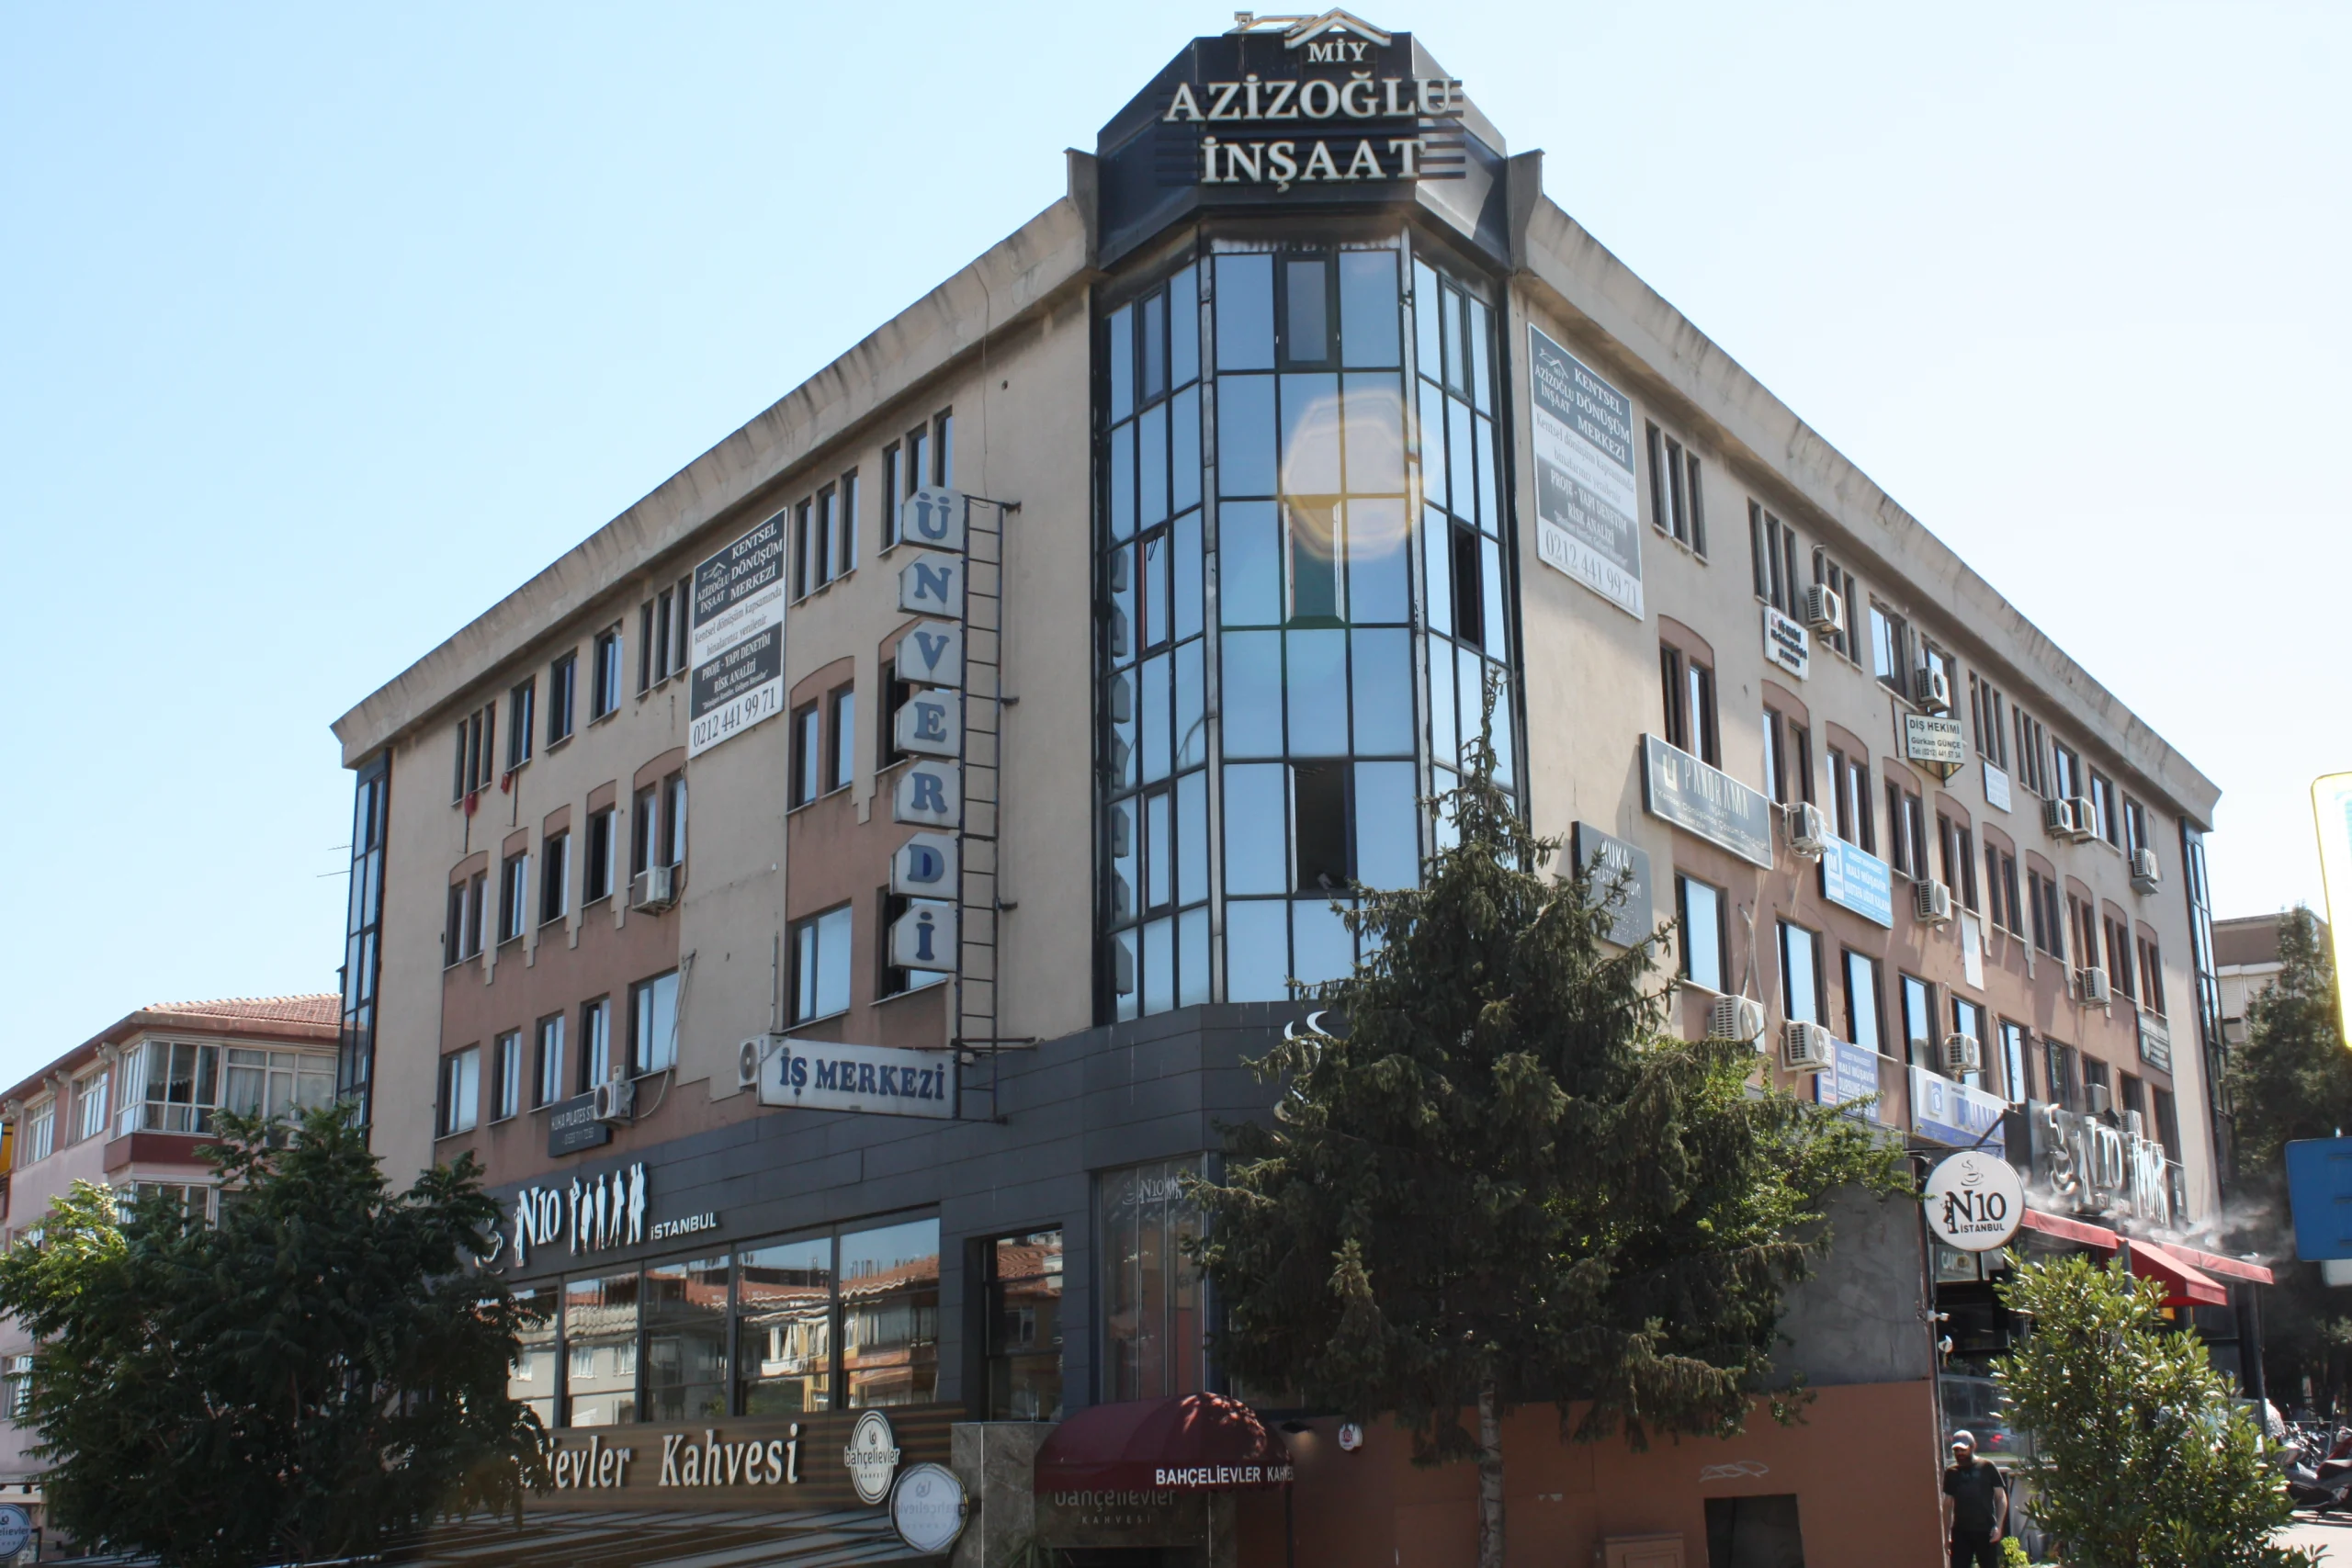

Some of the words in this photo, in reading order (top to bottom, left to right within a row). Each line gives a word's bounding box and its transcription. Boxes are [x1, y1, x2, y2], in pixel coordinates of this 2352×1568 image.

[1307, 38, 1368, 62] MİY
[1162, 71, 1453, 122] AZİZOĞLU
[1200, 136, 1426, 193] İNŞAAT
[1534, 364, 1574, 402] AZİZOĞLU
[1541, 380, 1569, 414] İNŞAAT
[1574, 367, 1623, 416] KENTSEL
[1536, 412, 1562, 441] Kentsel
[1576, 391, 1631, 445] DÖNÜŞÜM
[1577, 415, 1625, 463] MERKEZİ
[1551, 468, 1573, 496] PROJE
[1577, 488, 1595, 512] YAPI
[1596, 500, 1627, 535] DENETİM
[731, 523, 777, 559] KENTSEL
[1567, 502, 1585, 526] RİSK
[1587, 516, 1614, 546] ANALİZİ
[730, 538, 783, 581] DÖNÜŞÜM
[1545, 529, 1577, 570] 0212
[1581, 553, 1602, 586] 441
[1607, 568, 1622, 596] 99
[1624, 580, 1637, 607] 71
[696, 573, 730, 603] AZİZOĞLU
[730, 561, 775, 601] MERKEZİ
[700, 590, 726, 614] İNŞAAT
[695, 622, 716, 645] Kentsel
[717, 608, 744, 632] dönüşüm
[702, 660, 720, 681] PROJE
[725, 649, 740, 668] YAPI
[741, 633, 771, 659] DENETİM
[714, 673, 729, 693] RİSK
[729, 658, 756, 687] ANALİZİ
[694, 715, 719, 748] 0212
[721, 704, 741, 732] 441
[745, 694, 759, 721] 99
[763, 685, 775, 713] 71
[1909, 718, 1925, 732] DİŞ
[1927, 722, 1960, 735] HEKİMİ
[1911, 737, 1936, 746] Gürkan
[1937, 739, 1961, 750] GÜNÇE
[1684, 759, 1749, 820] PANORAMA
[1600, 840, 1629, 869] KUKA
[779, 1047, 807, 1096] İŞ
[815, 1059, 944, 1100] MERKEZİ
[1838, 1061, 1851, 1076] MALİ
[1140, 1179, 1164, 1203] N10
[514, 1186, 561, 1268] N10
[1943, 1190, 2007, 1234] N10
[1960, 1223, 2005, 1233] İSTANBUL
[658, 1423, 798, 1486] Kahvesi
[845, 1448, 899, 1469] bahçelievler
[1156, 1465, 1261, 1487] BAHÇELİEVLER
